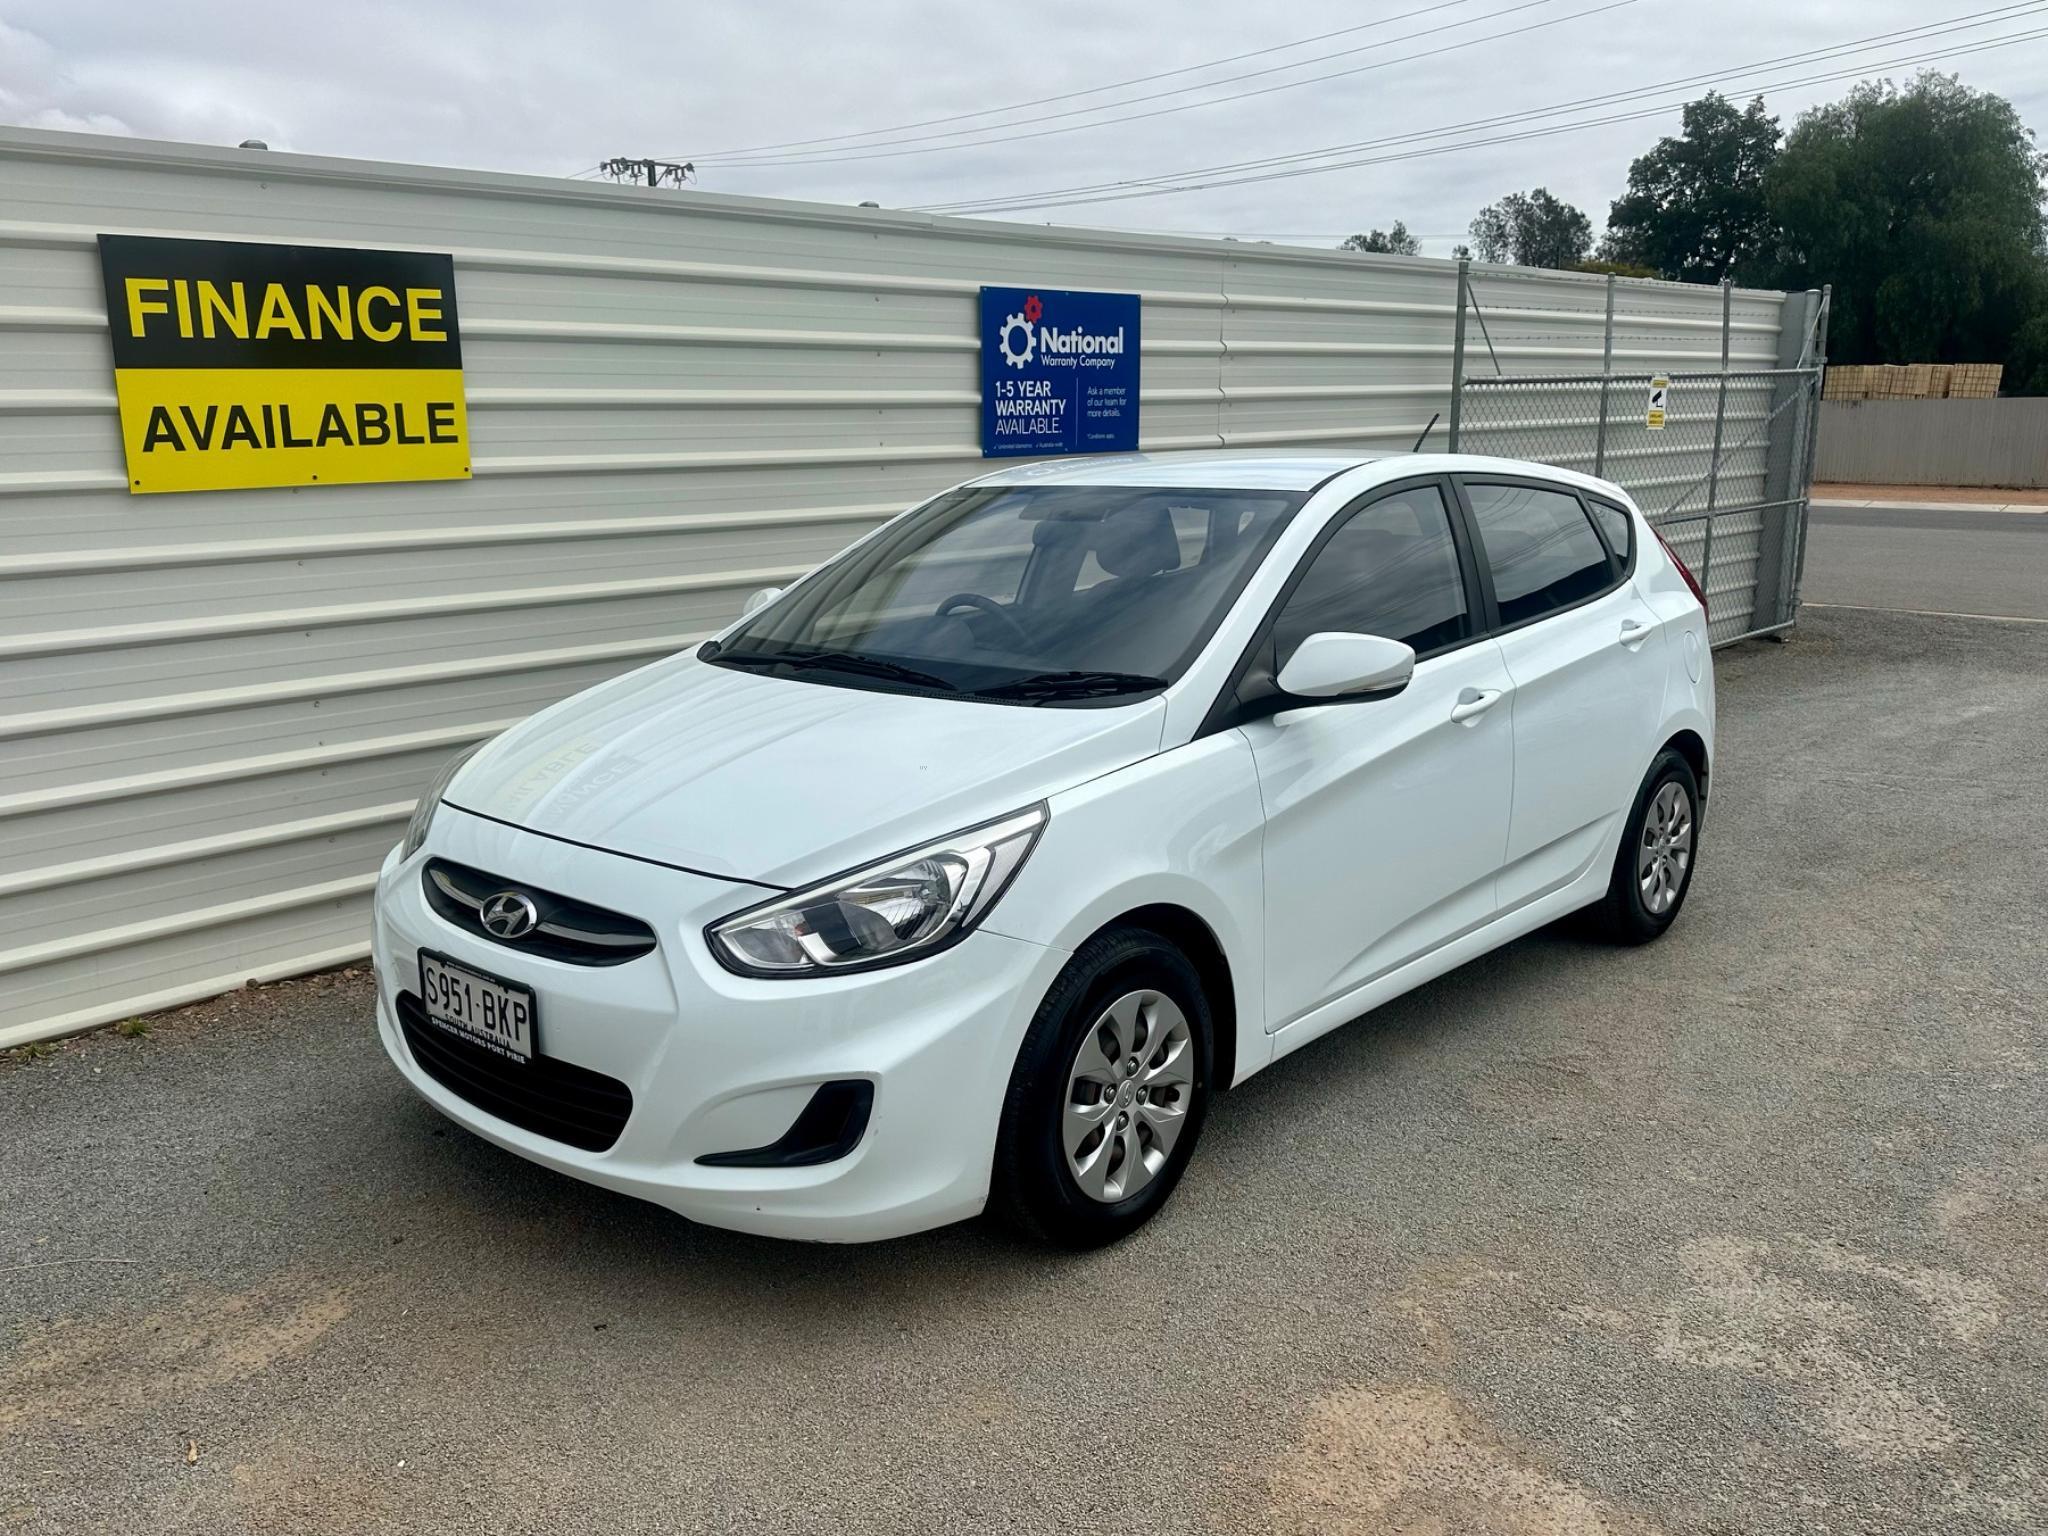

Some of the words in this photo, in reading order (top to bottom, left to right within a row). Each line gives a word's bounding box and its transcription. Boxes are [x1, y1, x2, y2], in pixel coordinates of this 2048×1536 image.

[125, 278, 448, 343] FINANCE
[1040, 326, 1124, 354] National
[1040, 354, 1077, 369] Warranty
[1079, 355, 1115, 370] Company
[995, 381, 1014, 397] 1-5
[1017, 380, 1051, 397] YEAR
[1087, 386, 1098, 395] Ask
[1103, 386, 1126, 395] member
[995, 399, 1066, 416] WARRANTY
[142, 402, 459, 452] AVAILABLE
[995, 417, 1062, 435] AVAILABLE.
[459, 1027, 486, 1048] MOTORS
[487, 1040, 506, 1056] PORT
[470, 1024, 511, 1049] AUSTRALIA
